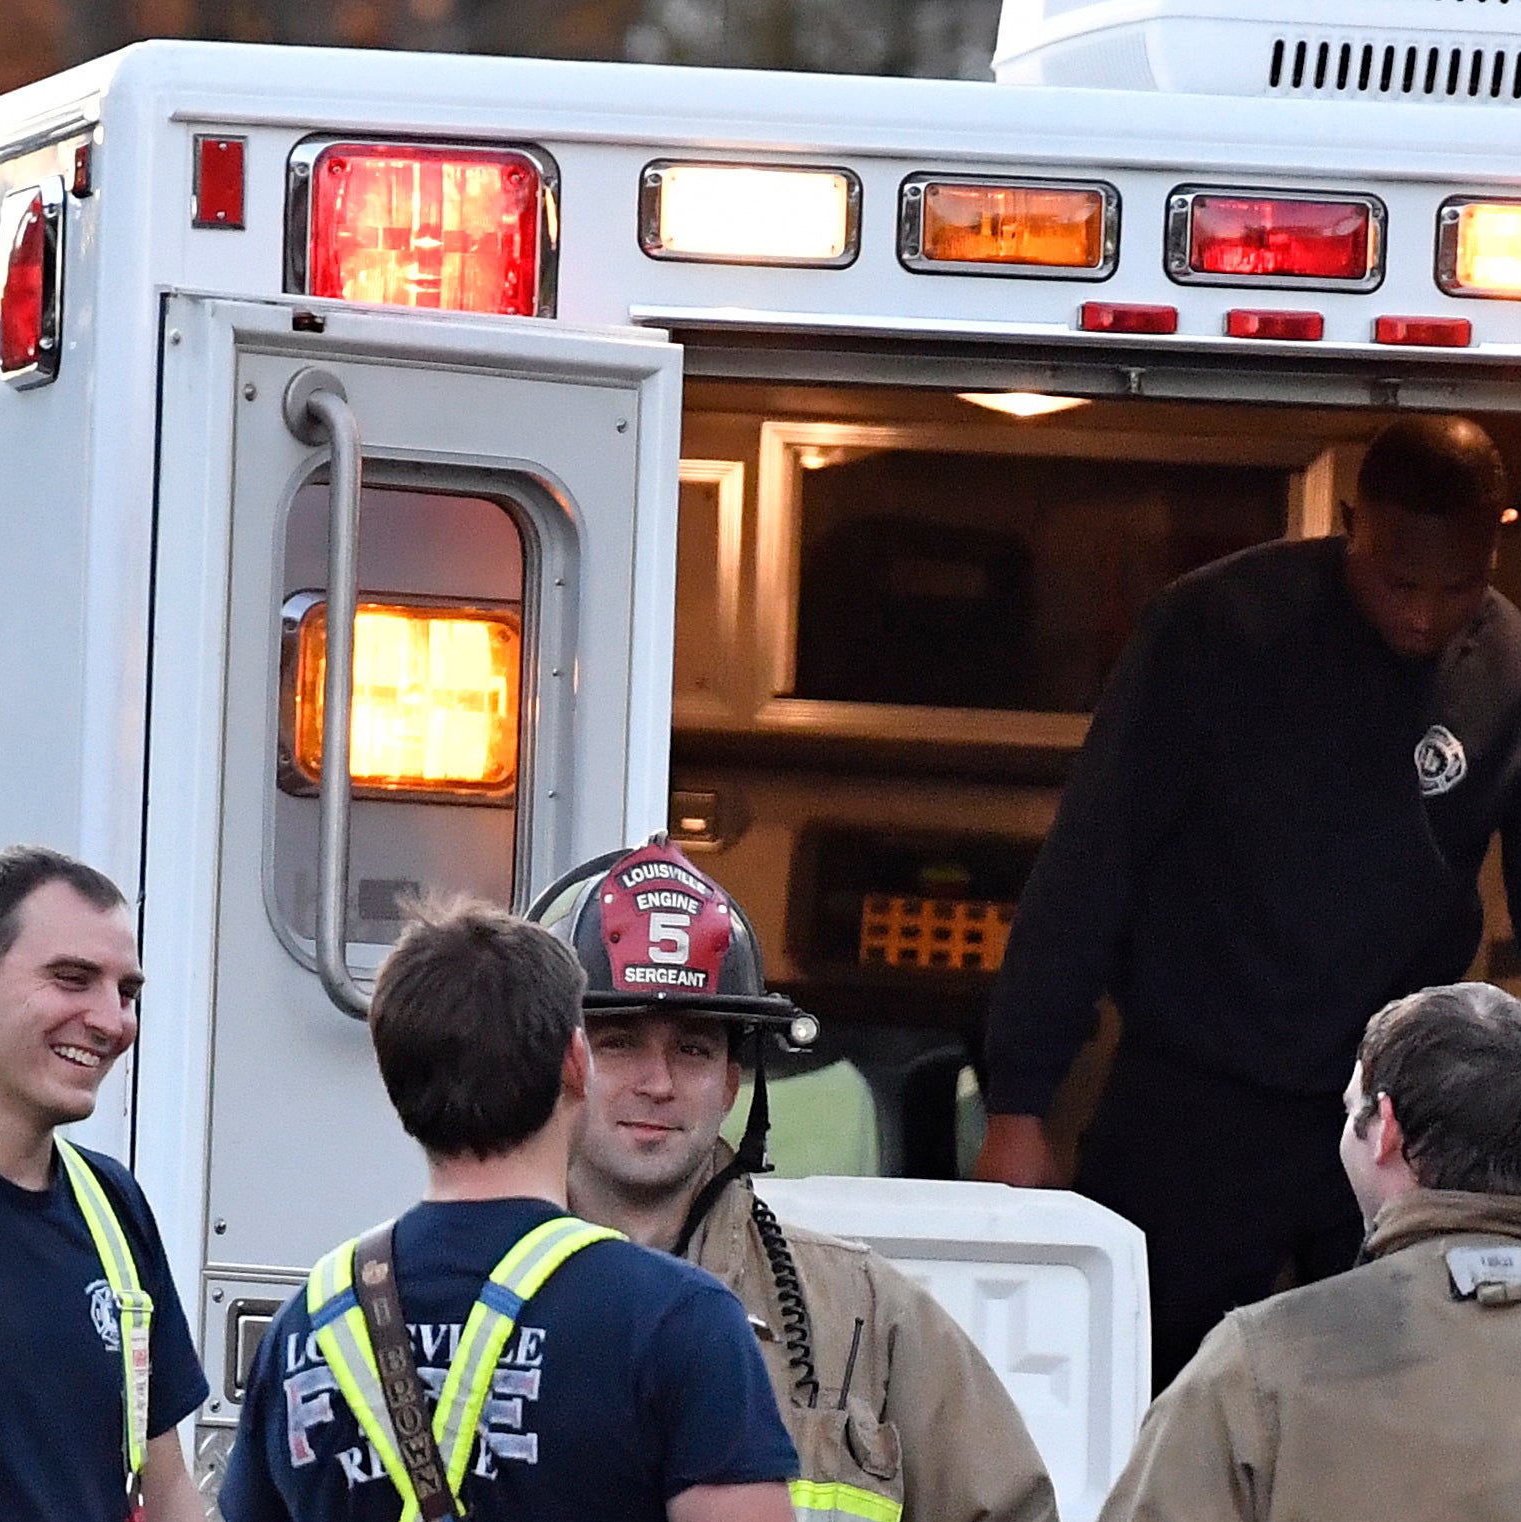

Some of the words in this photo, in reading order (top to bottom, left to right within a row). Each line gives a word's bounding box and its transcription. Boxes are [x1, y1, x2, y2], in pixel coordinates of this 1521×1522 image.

[622, 863, 707, 895] LOUISVILLE
[636, 891, 700, 915] ENGINE
[648, 911, 691, 965] 5
[624, 966, 707, 988] SERGEANT
